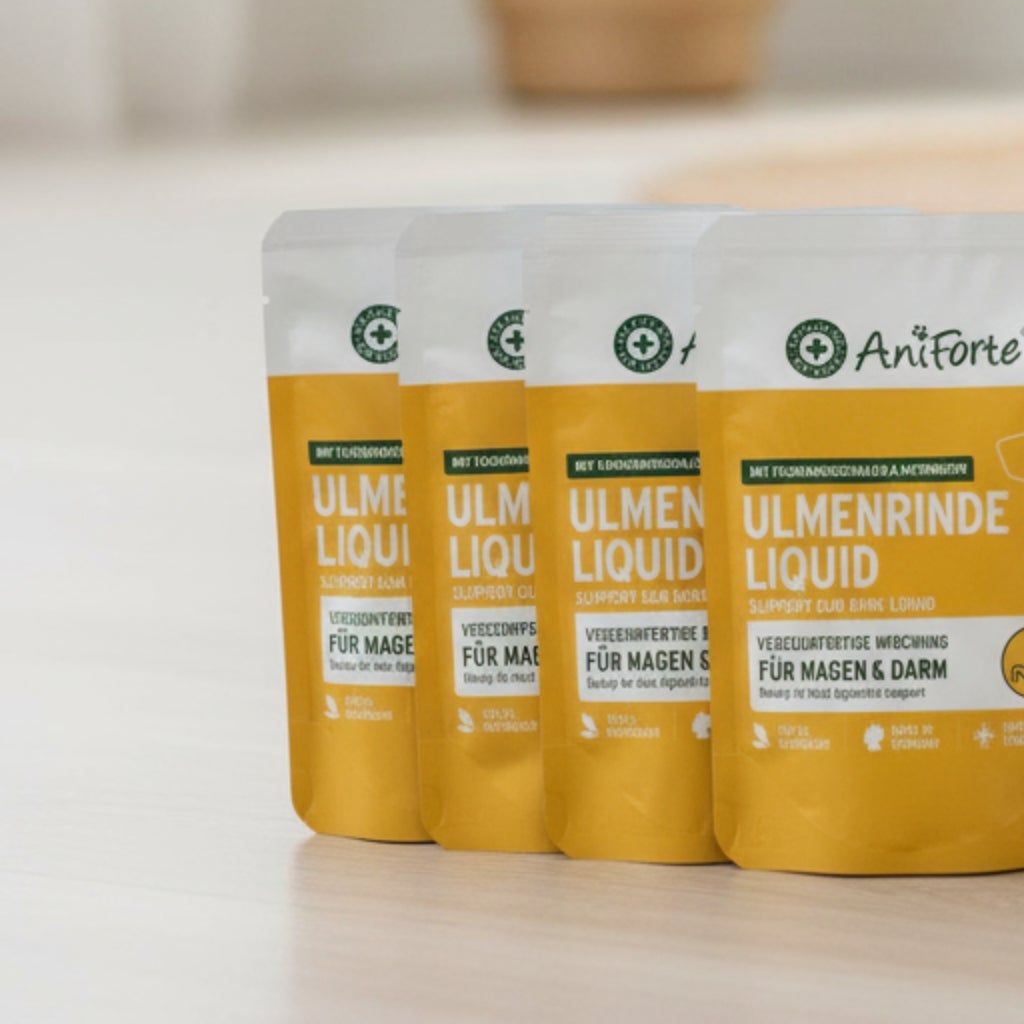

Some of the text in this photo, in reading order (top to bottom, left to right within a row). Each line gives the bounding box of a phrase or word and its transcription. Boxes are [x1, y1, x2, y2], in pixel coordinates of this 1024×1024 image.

[854, 324, 1022, 372] AniForte
[312, 473, 407, 517] ULME
[446, 482, 531, 527] ULM
[569, 485, 704, 533] ULMEN
[743, 491, 1010, 539] ULMENRINDE
[316, 523, 410, 568] LIQUI
[449, 533, 535, 578] LIQU
[572, 536, 704, 583] LIQUID
[745, 544, 880, 592] LIQUID
[329, 627, 415, 655] FÜR MAGE
[462, 640, 498, 667] FÜR
[586, 645, 622, 673] FÜR
[627, 649, 694, 672] MAGEN
[759, 656, 795, 681] FÜR
[872, 660, 885, 681] &
[891, 659, 948, 680] DARM
